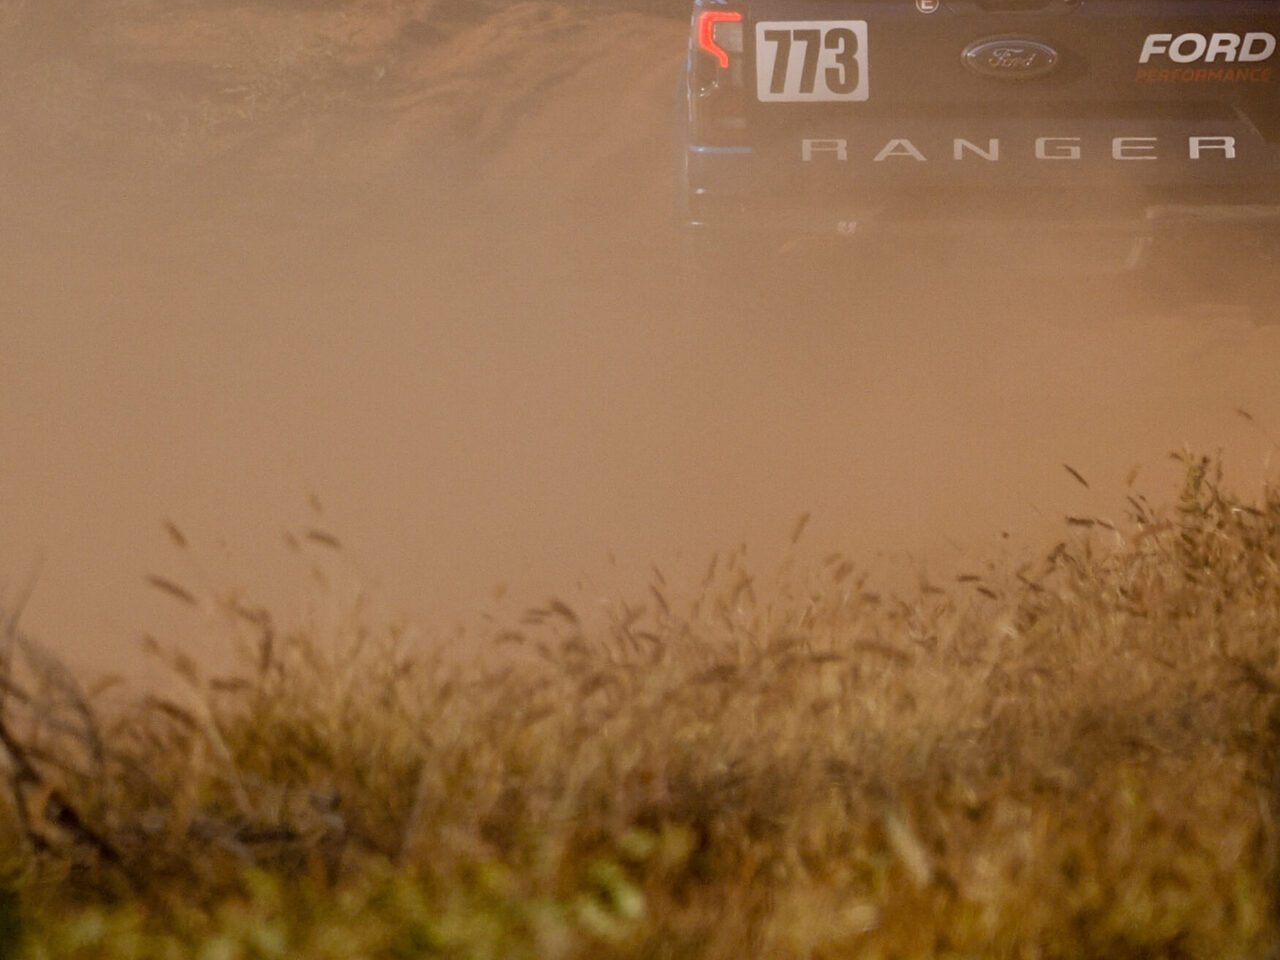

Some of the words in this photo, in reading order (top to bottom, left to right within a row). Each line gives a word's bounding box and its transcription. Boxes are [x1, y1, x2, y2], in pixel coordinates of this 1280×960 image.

[988, 47, 1037, 67] Ford
[1138, 32, 1276, 63] FORD
[764, 27, 861, 95] 773
[1135, 67, 1272, 82] PERFORMANCE
[802, 136, 1236, 161] RANGER
